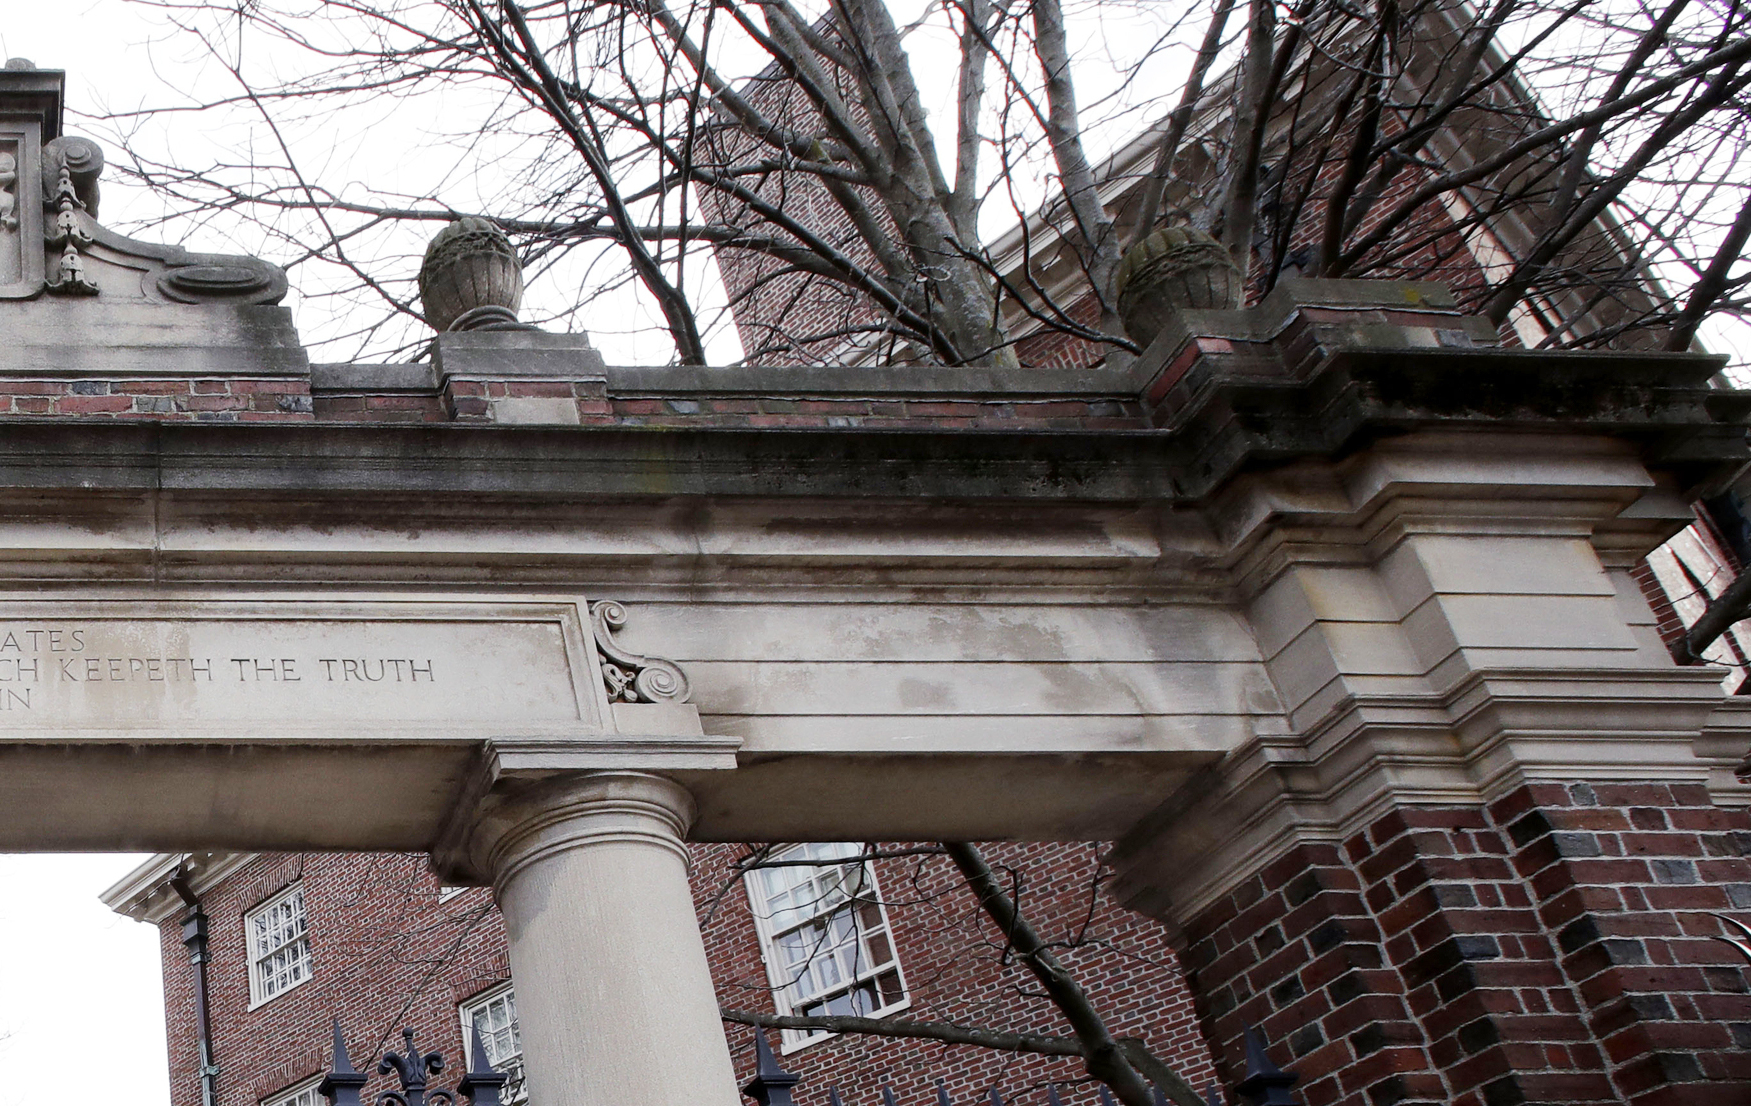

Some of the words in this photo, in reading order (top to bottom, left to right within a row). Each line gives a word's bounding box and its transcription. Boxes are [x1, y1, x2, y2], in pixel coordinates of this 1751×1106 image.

[60, 658, 214, 683] KEEPETH
[230, 658, 302, 683] THE
[319, 658, 436, 683] TRUTH
